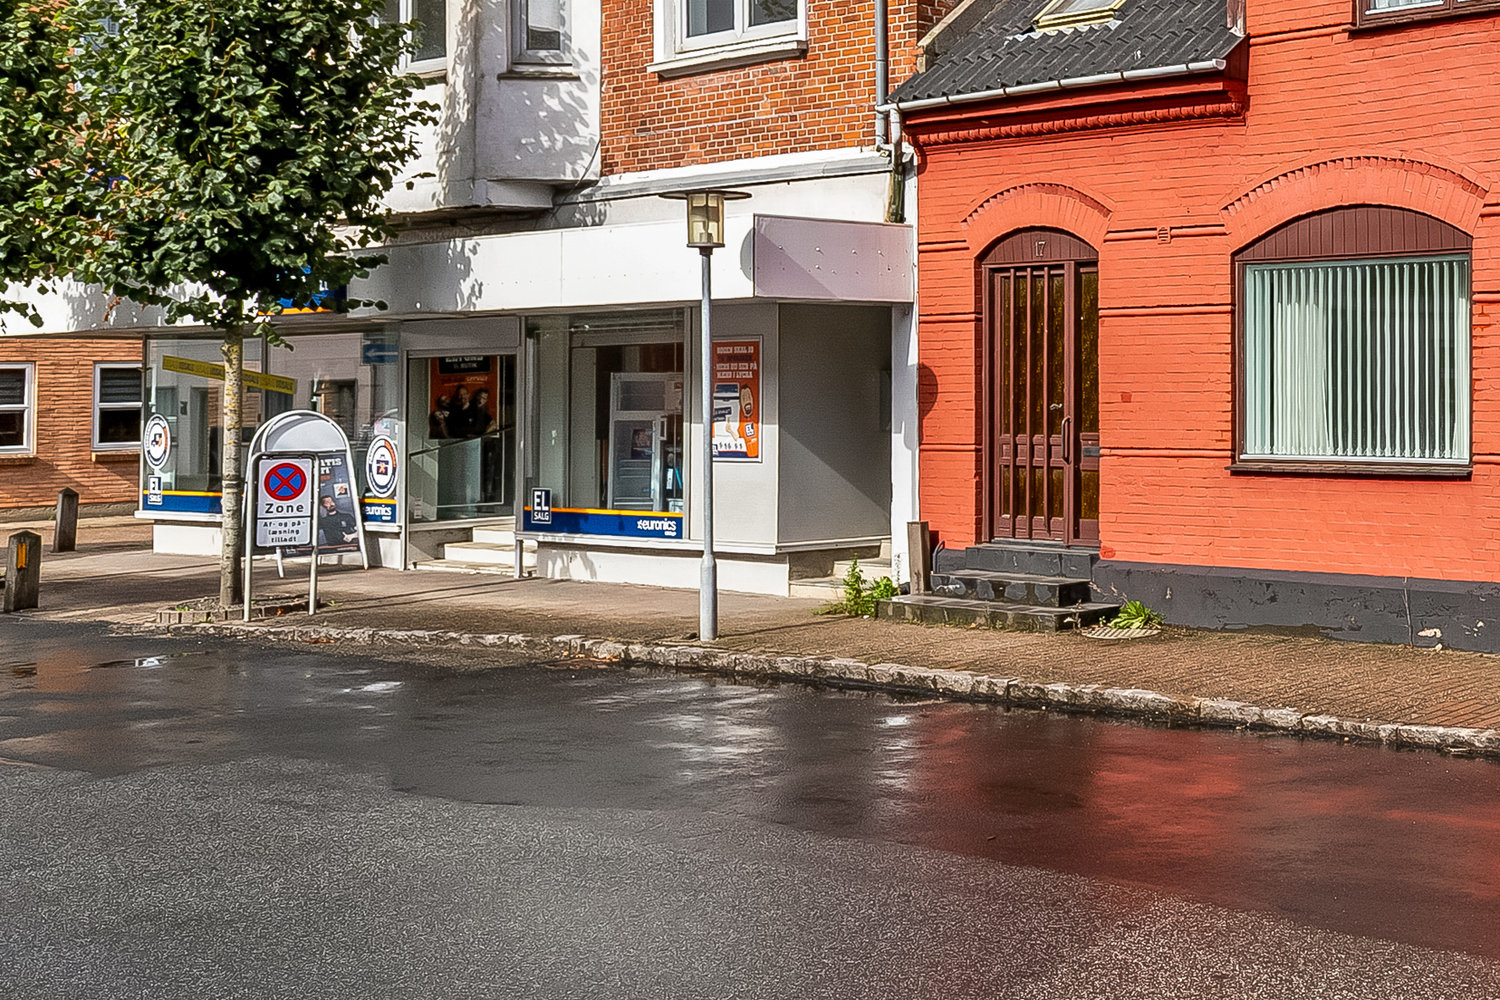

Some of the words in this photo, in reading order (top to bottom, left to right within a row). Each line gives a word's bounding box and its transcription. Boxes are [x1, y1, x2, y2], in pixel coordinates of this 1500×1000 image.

[1035, 241, 1046, 256] 17
[534, 491, 549, 510] EL
[265, 503, 304, 514] Zone
[534, 512, 549, 520] SALG
[643, 518, 677, 531] euronics
